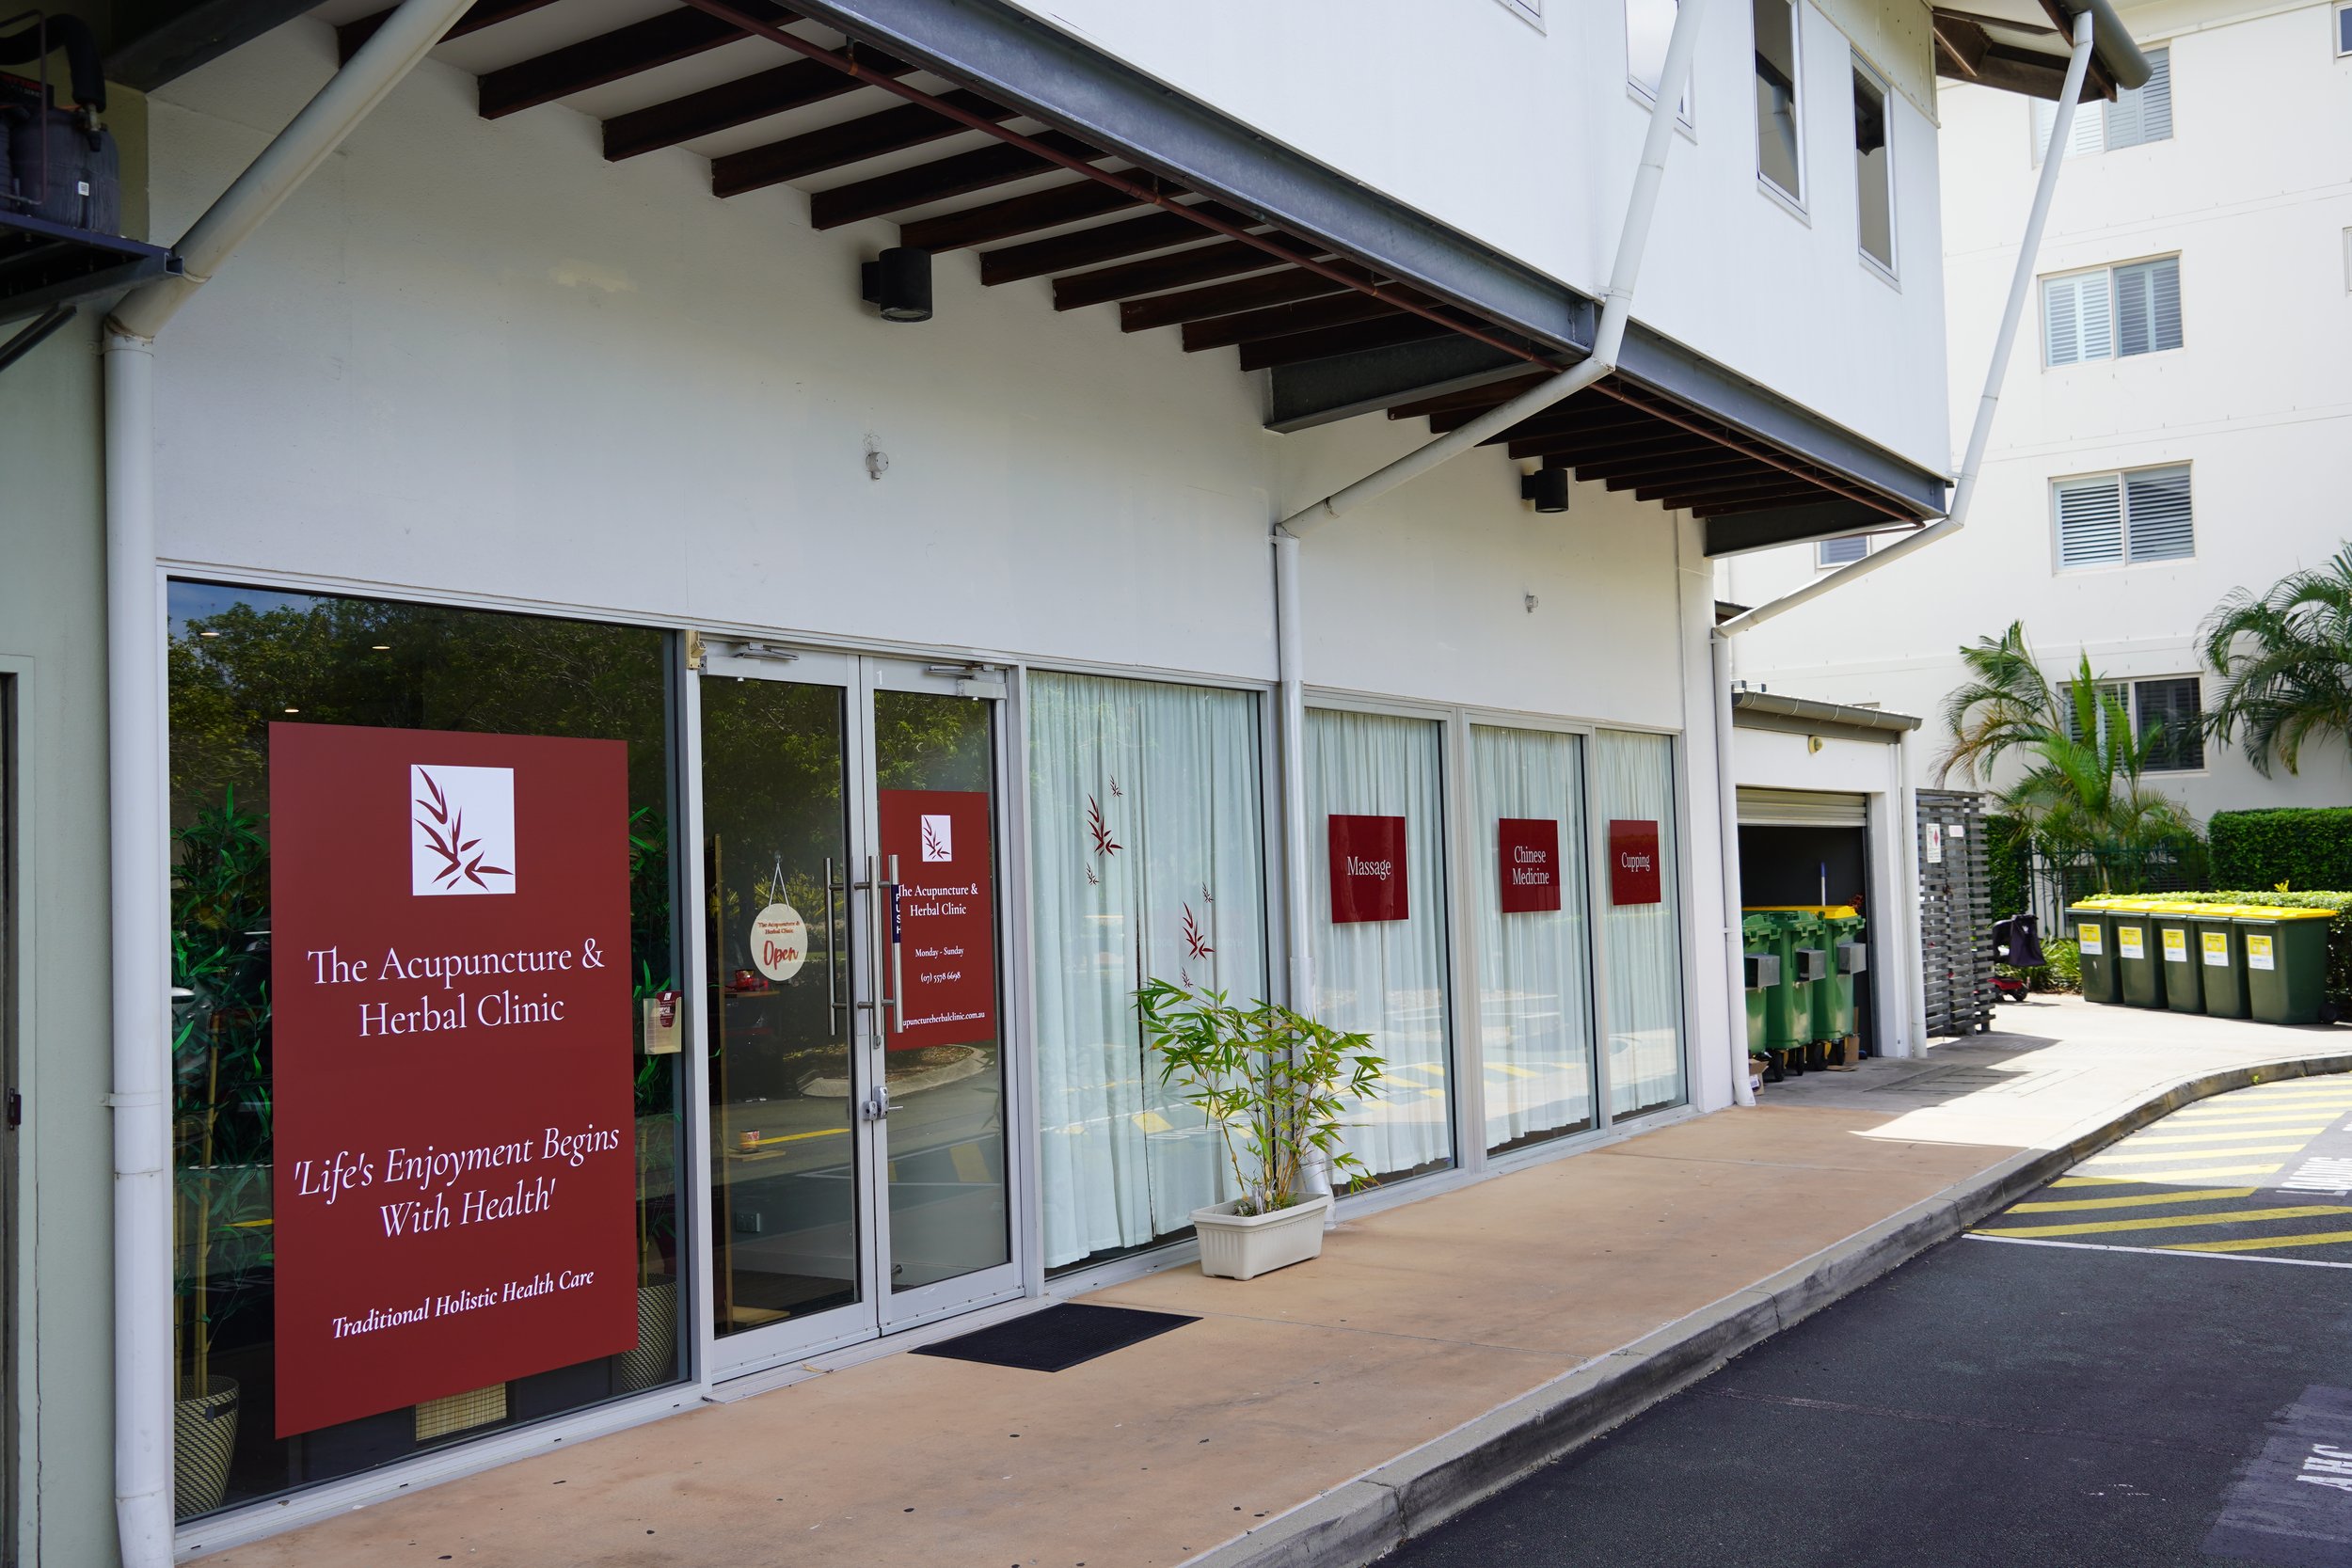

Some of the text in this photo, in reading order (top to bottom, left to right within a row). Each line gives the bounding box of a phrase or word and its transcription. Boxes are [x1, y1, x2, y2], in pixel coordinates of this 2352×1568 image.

[877, 670, 882, 685] 1
[1514, 846, 1547, 863] Chinese
[1621, 852, 1650, 872] Cupping
[1347, 856, 1391, 880] Massage
[1512, 867, 1549, 886] Medicine
[898, 883, 977, 900] The Acupuncture &
[911, 902, 966, 916] Herbal Clinic
[764, 941, 799, 970] Open
[915, 947, 938, 958] Monday
[944, 945, 963, 957] Sunday
[307, 938, 605, 990] The Acupuncture &
[921, 973, 931, 984] (07)
[947, 972, 961, 981] 6698
[359, 990, 564, 1037] Herbal Clinic
[903, 1012, 985, 1028] upunctureherbalclinic.com.au
[294, 1124, 620, 1205] 'Life's Enjoyment Begins
[380, 1177, 557, 1238] With Health'
[332, 1269, 595, 1338] Traditional Holistic Health Care
